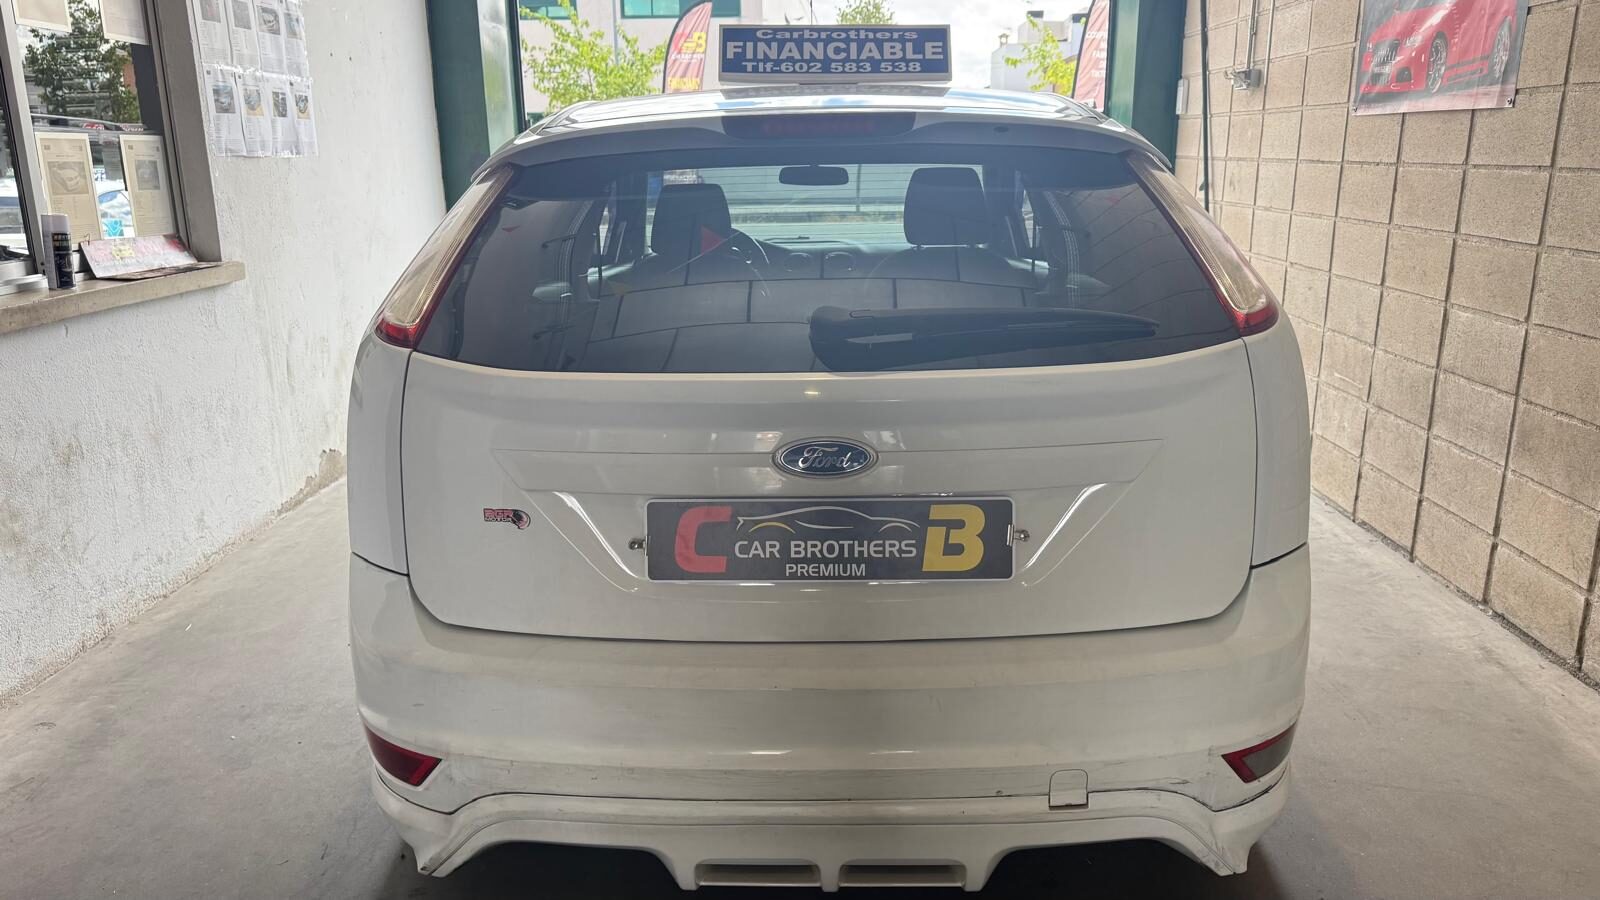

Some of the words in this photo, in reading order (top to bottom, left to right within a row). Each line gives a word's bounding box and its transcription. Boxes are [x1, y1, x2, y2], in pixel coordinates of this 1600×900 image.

[755, 29, 918, 40] Carbrothers
[726, 41, 944, 60] FINANCIABLE
[742, 62, 822, 73] Tlf-602
[830, 62, 872, 73] 583
[879, 62, 922, 73] 538
[798, 446, 852, 468] Ford
[674, 505, 733, 573] C
[921, 503, 986, 572] B
[734, 540, 780, 559] CAR
[790, 540, 917, 559] BROTHERS
[785, 563, 866, 577] PREMIUM
